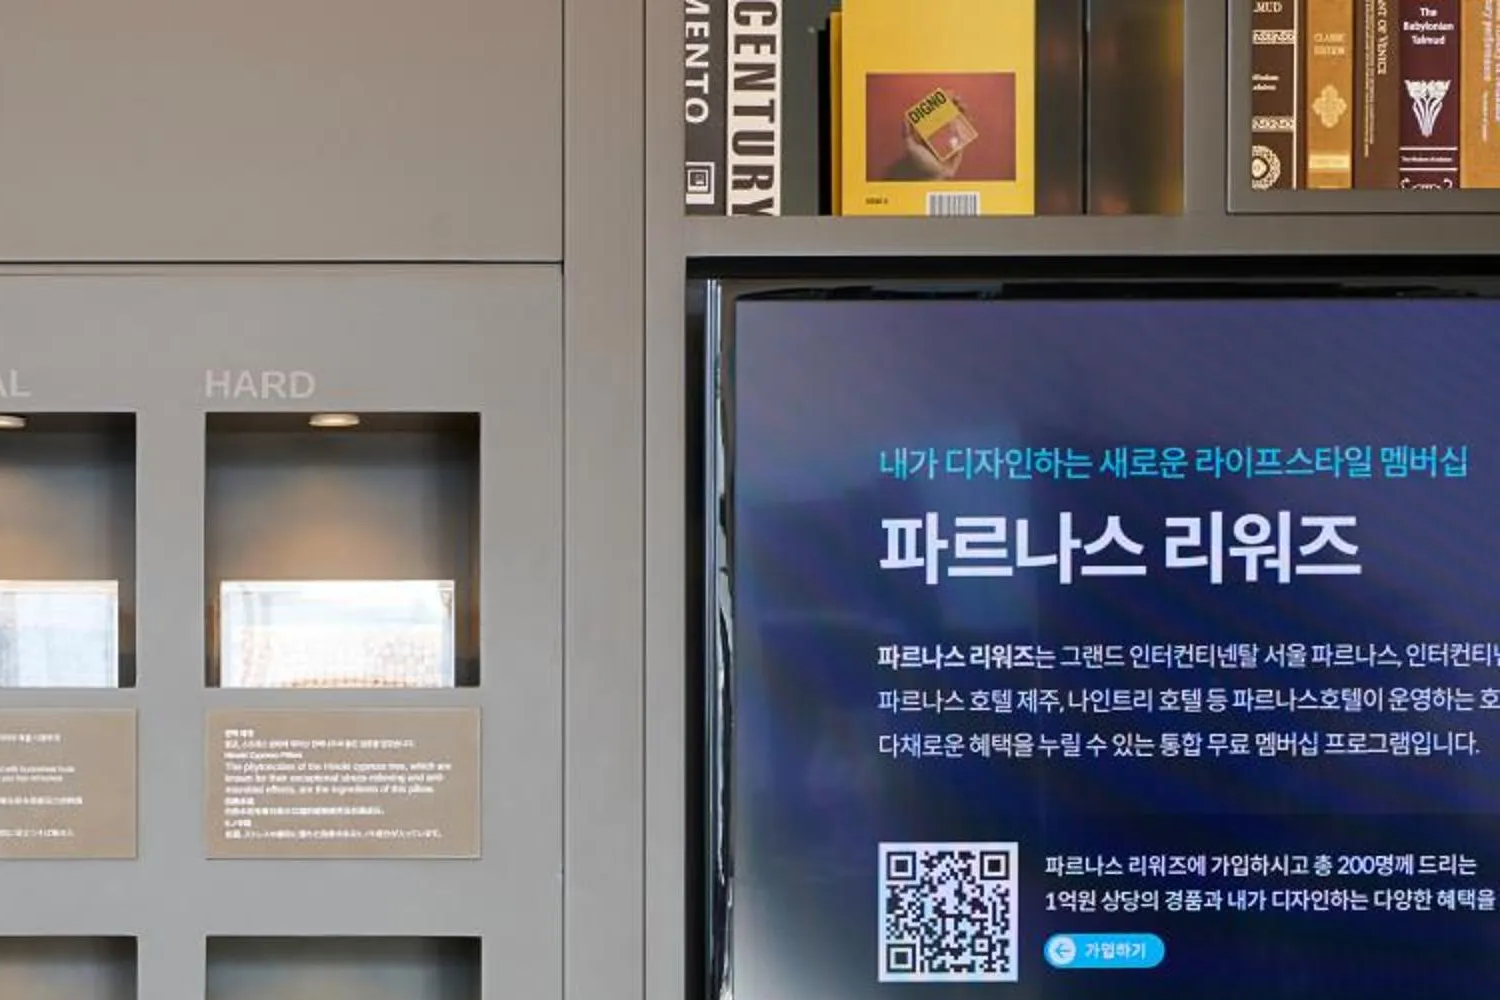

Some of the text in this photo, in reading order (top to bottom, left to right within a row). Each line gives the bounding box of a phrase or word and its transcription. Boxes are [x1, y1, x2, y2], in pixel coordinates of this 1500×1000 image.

[1419, 7, 1438, 17] The
[1403, 21, 1455, 32] Babylonian
[1411, 34, 1445, 45] Talmud
[1377, 35, 1389, 75] VENICE
[731, 1, 778, 216] CENTURY
[906, 90, 948, 124] DIGNO
[205, 370, 315, 399] HARD
[879, 444, 1468, 481] 내가 디자인하는 새로운 라이프스타일 멤버십
[879, 510, 1362, 585] 파르나스 리워즈
[877, 644, 966, 670] 파르나스
[969, 644, 1056, 669] 리워즈는
[1060, 644, 1125, 669] 그랜드
[1129, 643, 1259, 669] 인터컨티넨탈
[1264, 643, 1306, 669] 서울
[1311, 643, 1402, 668] 파르나스,
[877, 688, 965, 713] 파르나스
[969, 688, 1013, 713] 호텔
[1017, 688, 1065, 713] 제주,
[1068, 688, 1153, 713] 나인트리
[1159, 688, 1201, 713] 호텔
[1206, 688, 1228, 712] 등
[1232, 687, 1383, 712] 파르나스호텔이
[1388, 687, 1474, 712] 운영하는
[878, 731, 1480, 758] 다채로운 혜택을 누릴 수 있는 통합 무료 멤버십 프로그램입니다.
[1045, 854, 1477, 877] 파르나스 리워즈에 가입하시고 총 200명께 드리는
[1045, 889, 1496, 912] 1억원 상당의 경품과 내가 디자인하는 다양한 혜택을
[1085, 942, 1146, 960] 가입하기
